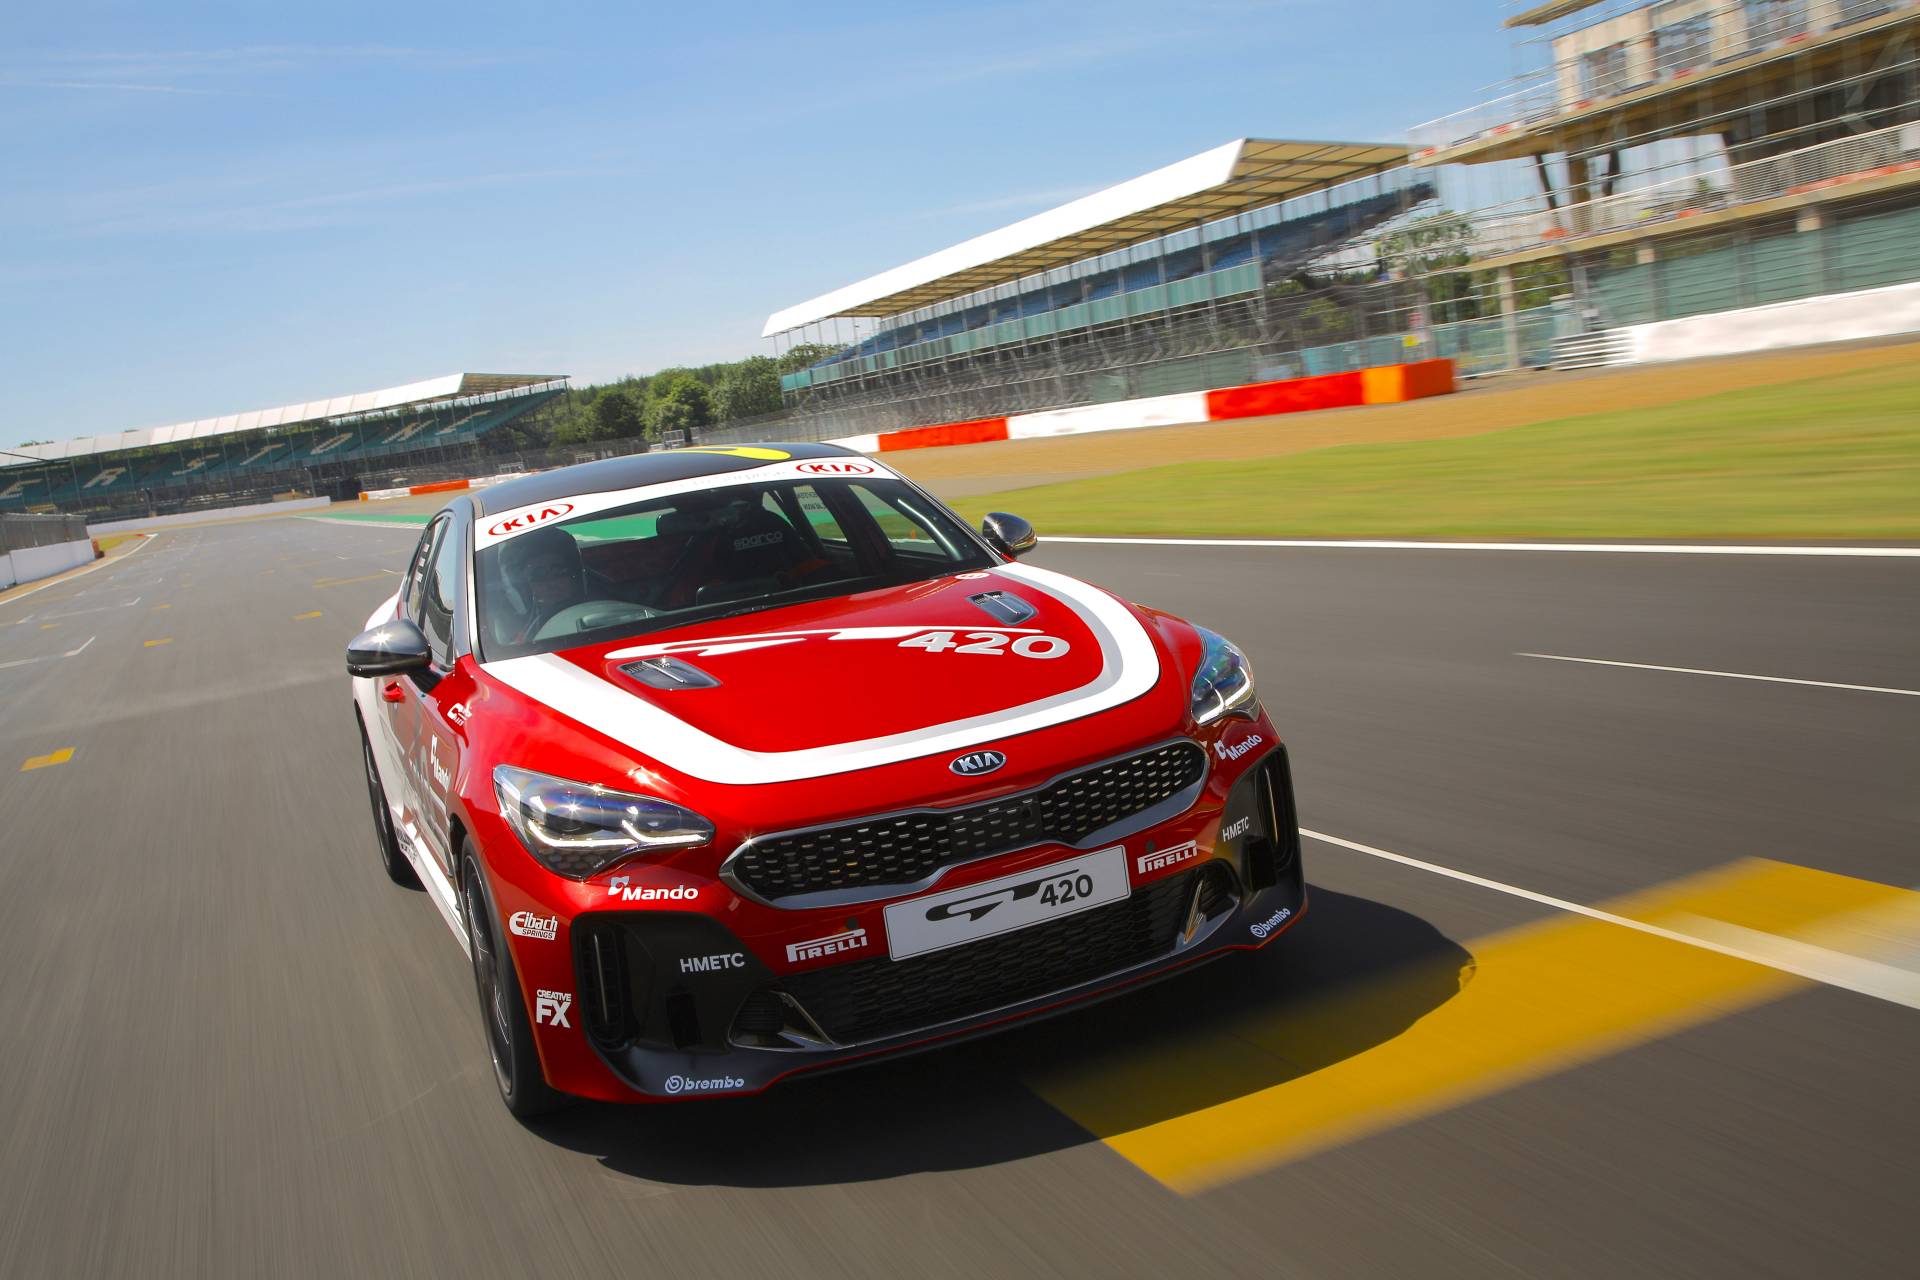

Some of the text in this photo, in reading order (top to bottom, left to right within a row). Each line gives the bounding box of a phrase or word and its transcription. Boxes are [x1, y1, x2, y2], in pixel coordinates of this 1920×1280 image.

[811, 464, 862, 472] KIA
[503, 510, 551, 531] KIA
[734, 531, 784, 549] sparco
[899, 631, 1070, 659] 420
[1226, 734, 1262, 761] Mando
[962, 752, 1000, 771] KIA
[1222, 816, 1249, 842] HMETC
[1137, 840, 1198, 874] PIRELLI
[622, 885, 698, 901] Mando
[1040, 874, 1093, 907] 420
[509, 911, 558, 935] Eibach
[1260, 907, 1291, 931] brembo
[522, 929, 553, 939] SPRINGS
[786, 928, 867, 963] PIRELLI
[680, 953, 745, 973] HMETC
[536, 989, 572, 1002] CREATIVE
[536, 999, 571, 1028] FX
[685, 1076, 744, 1090] brembo
